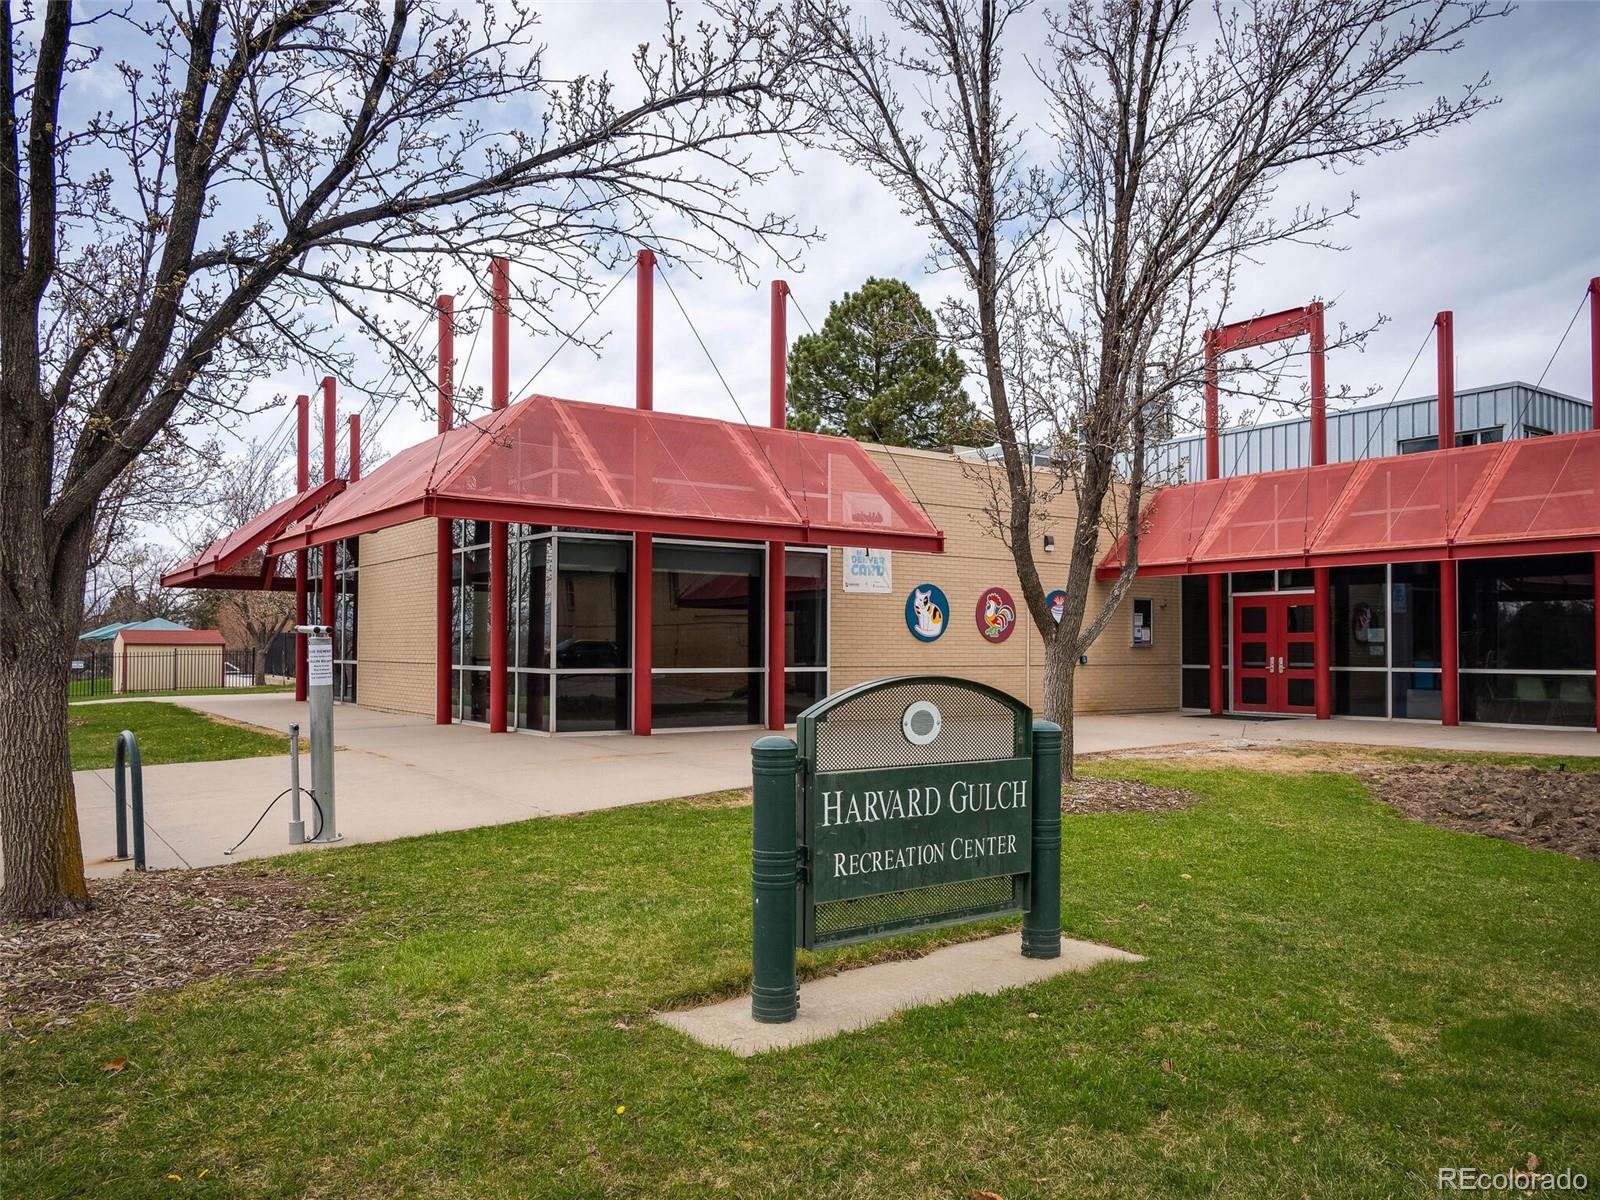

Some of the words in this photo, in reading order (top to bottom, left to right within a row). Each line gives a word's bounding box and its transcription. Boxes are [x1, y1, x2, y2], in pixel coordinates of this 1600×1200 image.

[822, 786, 941, 827] HARVARD
[949, 780, 1028, 814] GULCH
[833, 842, 945, 878] RECREATION
[950, 834, 1017, 861] CENTER
